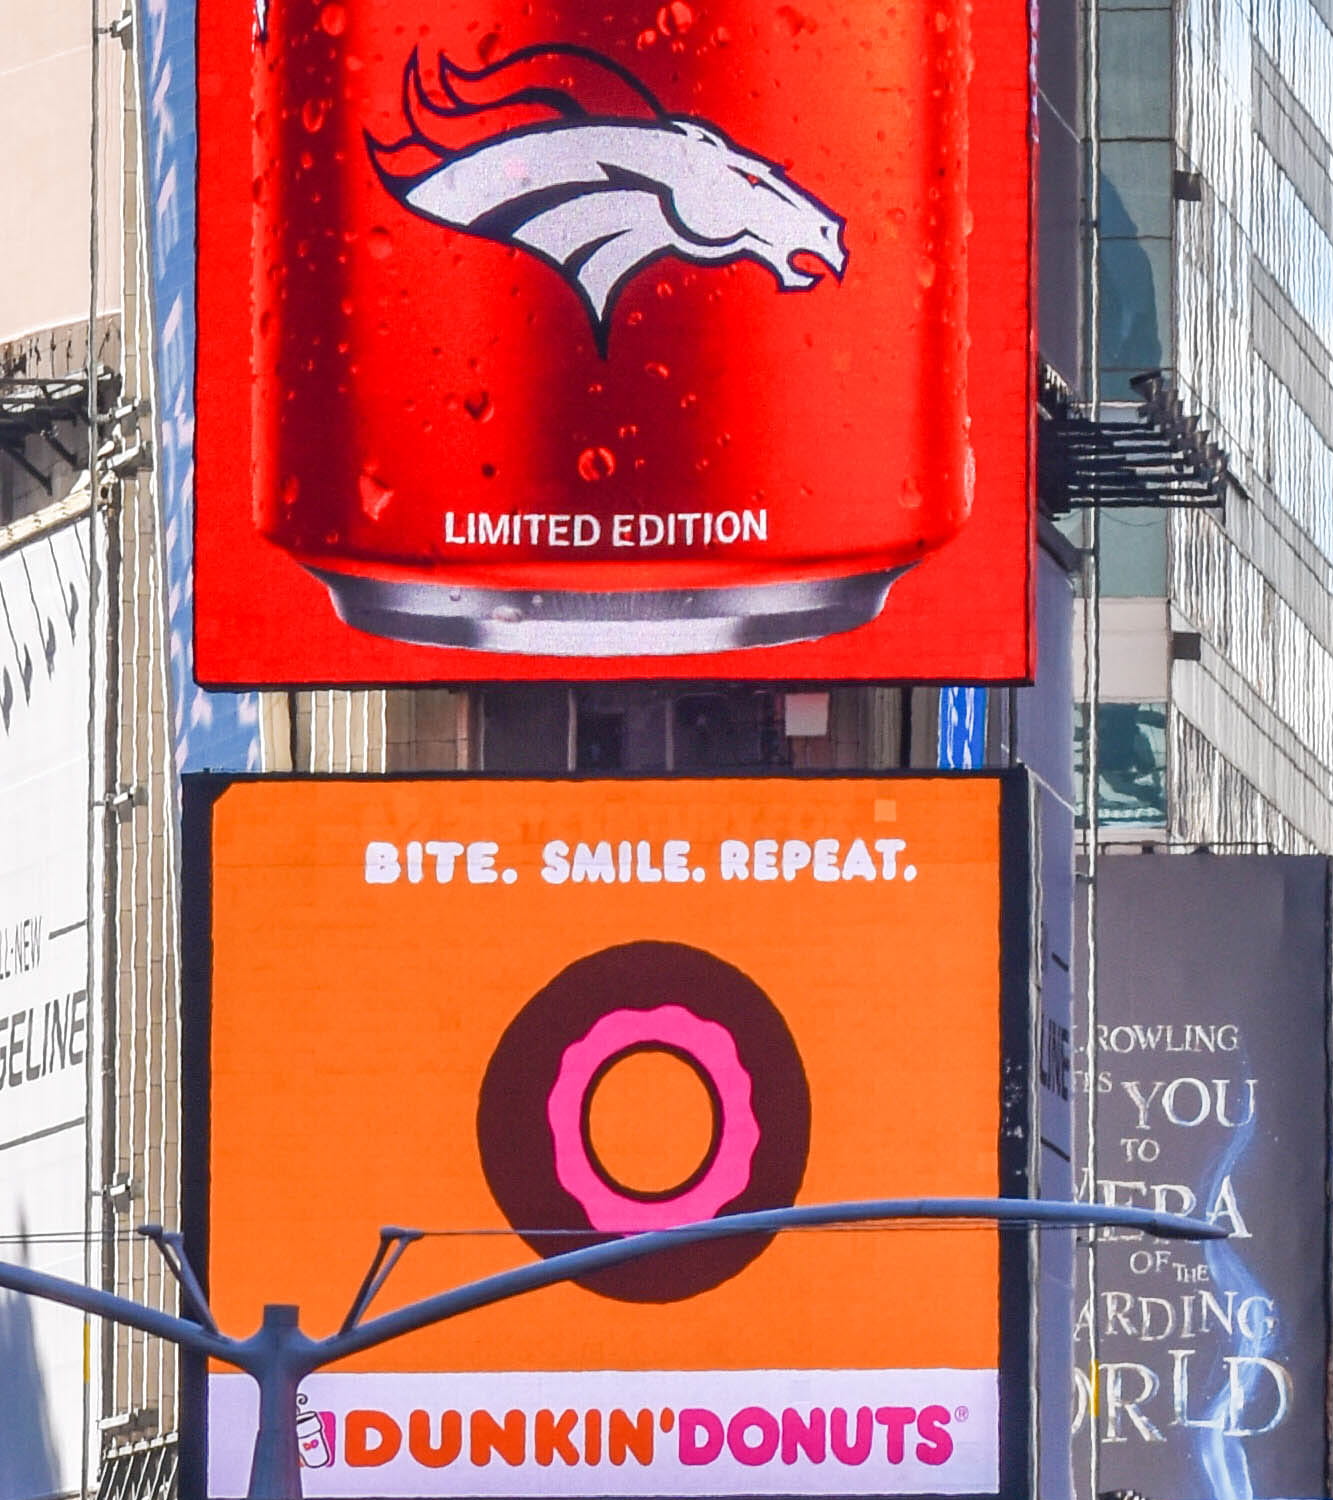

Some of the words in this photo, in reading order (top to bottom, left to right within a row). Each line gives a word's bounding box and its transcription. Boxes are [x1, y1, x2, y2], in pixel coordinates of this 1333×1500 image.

[444, 512, 602, 546] LIMITED
[612, 510, 767, 546] EDITION
[364, 843, 518, 885] BITE.
[541, 840, 706, 884] SMILE.
[720, 838, 917, 882] REPEAT.
[1122, 1077, 1258, 1130] YOU
[1121, 1138, 1160, 1163] TO
[1129, 1250, 1172, 1275] OF
[1172, 1261, 1210, 1284] THE
